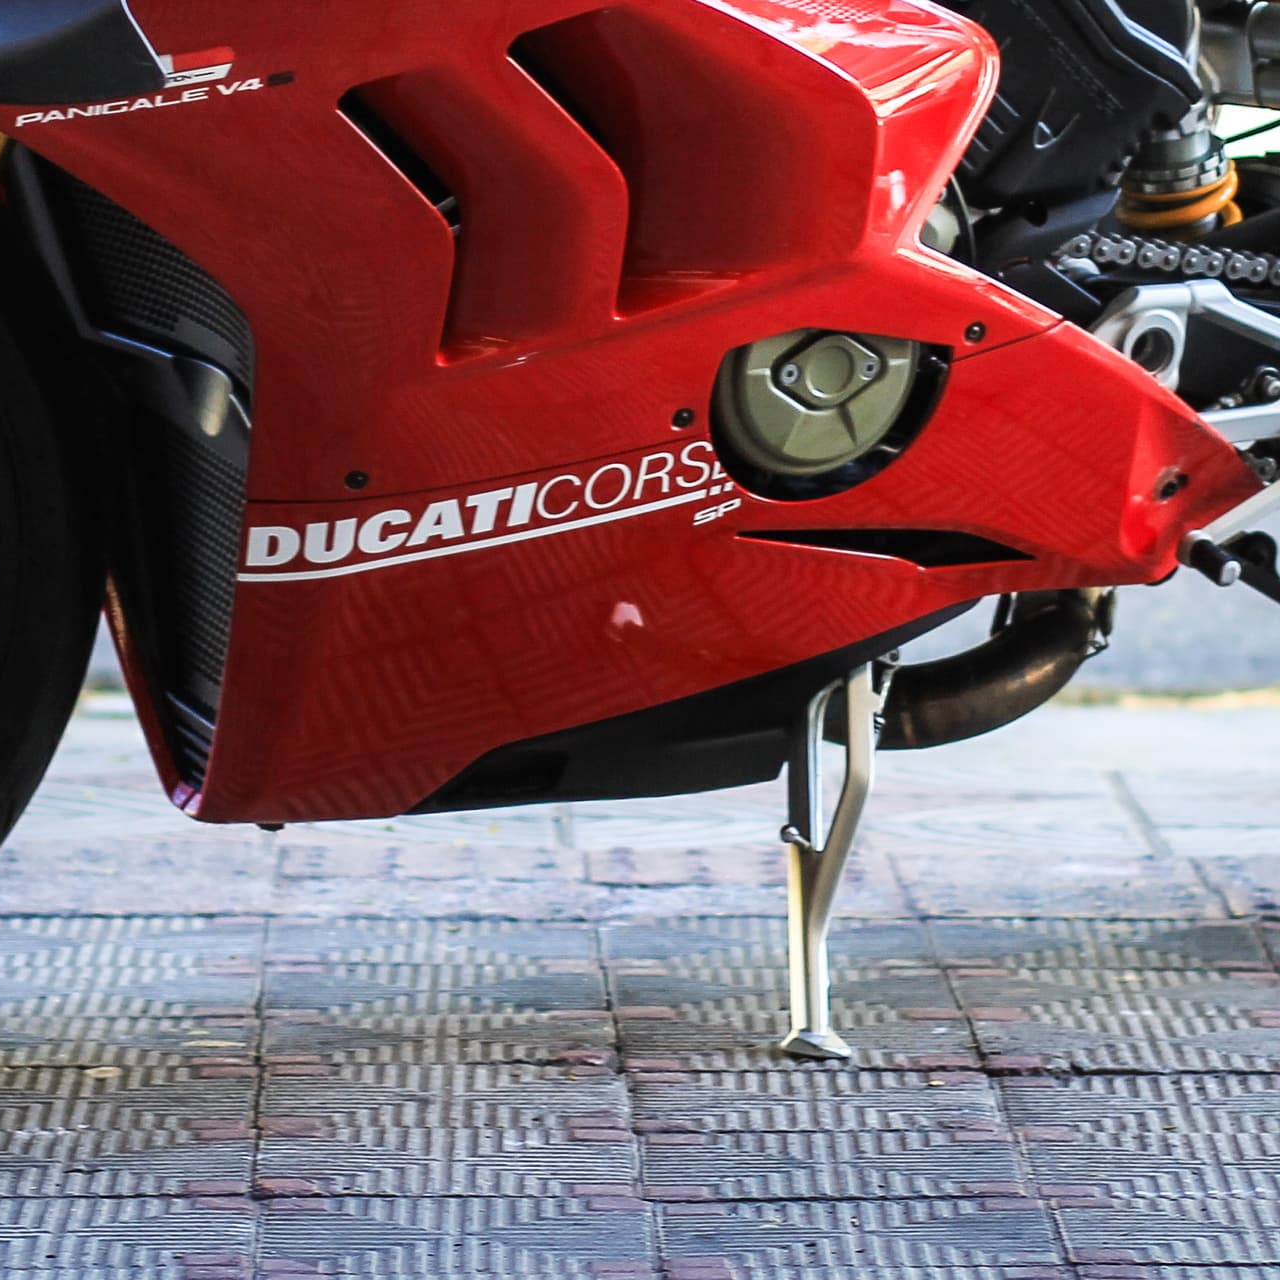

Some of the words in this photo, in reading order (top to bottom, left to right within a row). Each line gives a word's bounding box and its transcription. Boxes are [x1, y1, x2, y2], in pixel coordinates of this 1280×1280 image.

[15, 87, 209, 127] PANIGALE
[216, 77, 264, 96] V4
[692, 497, 742, 526] SP
